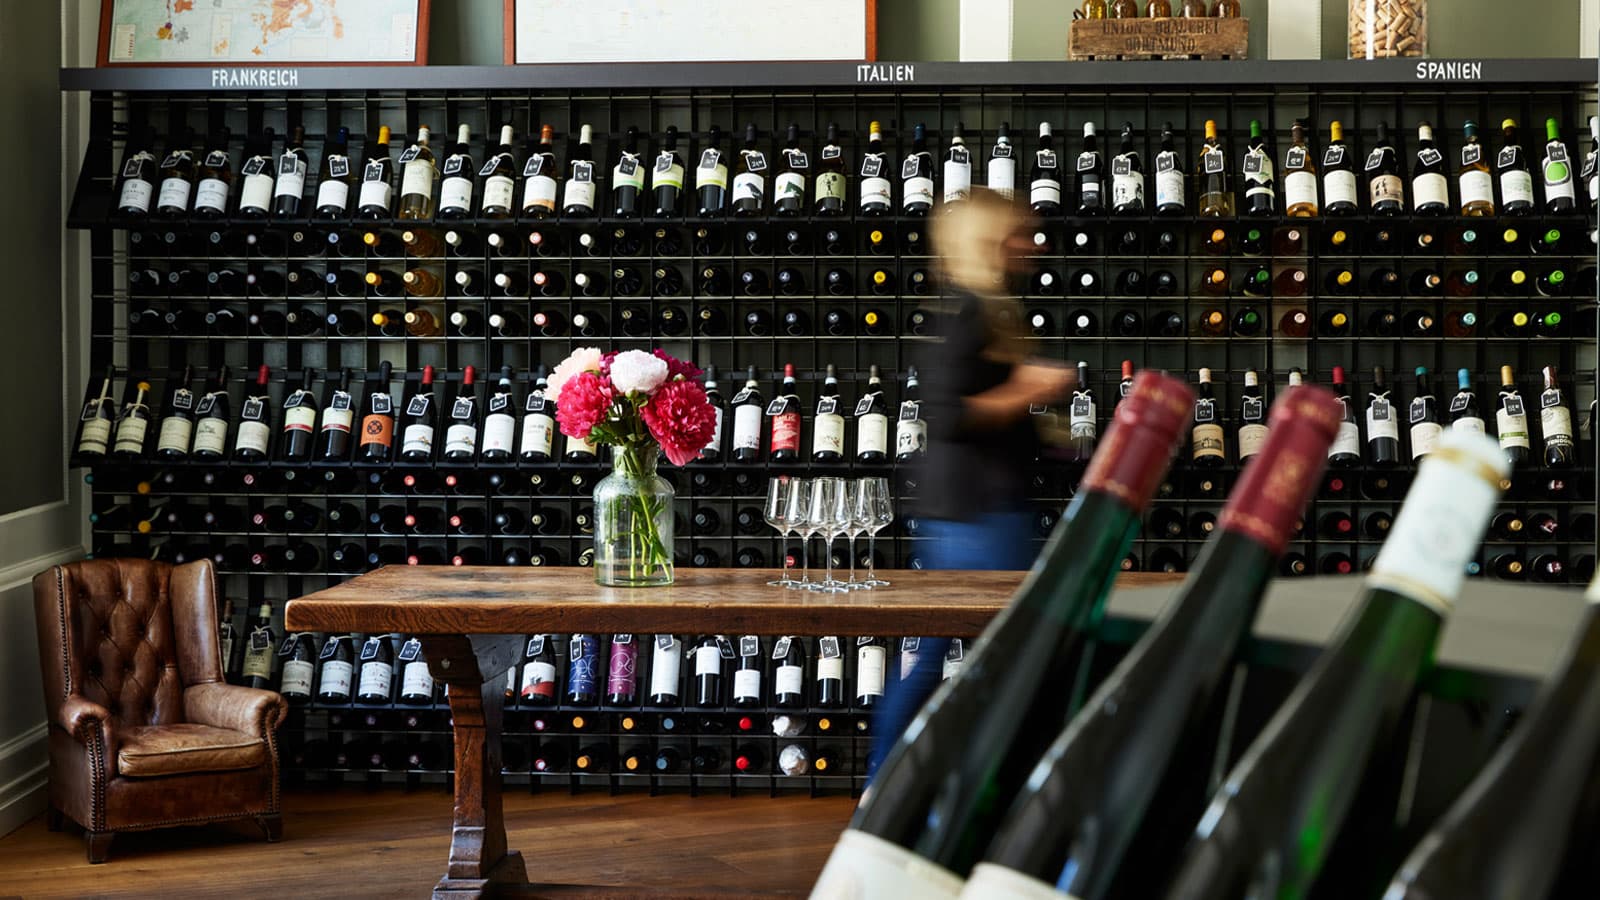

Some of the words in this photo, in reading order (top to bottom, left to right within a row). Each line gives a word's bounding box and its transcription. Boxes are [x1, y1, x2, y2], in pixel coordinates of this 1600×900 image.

[1125, 38, 1195, 51] DORTMUND
[212, 69, 298, 87] FRANKREICH
[857, 65, 914, 82] ITALIEN
[1416, 62, 1481, 80] SPANIEN
